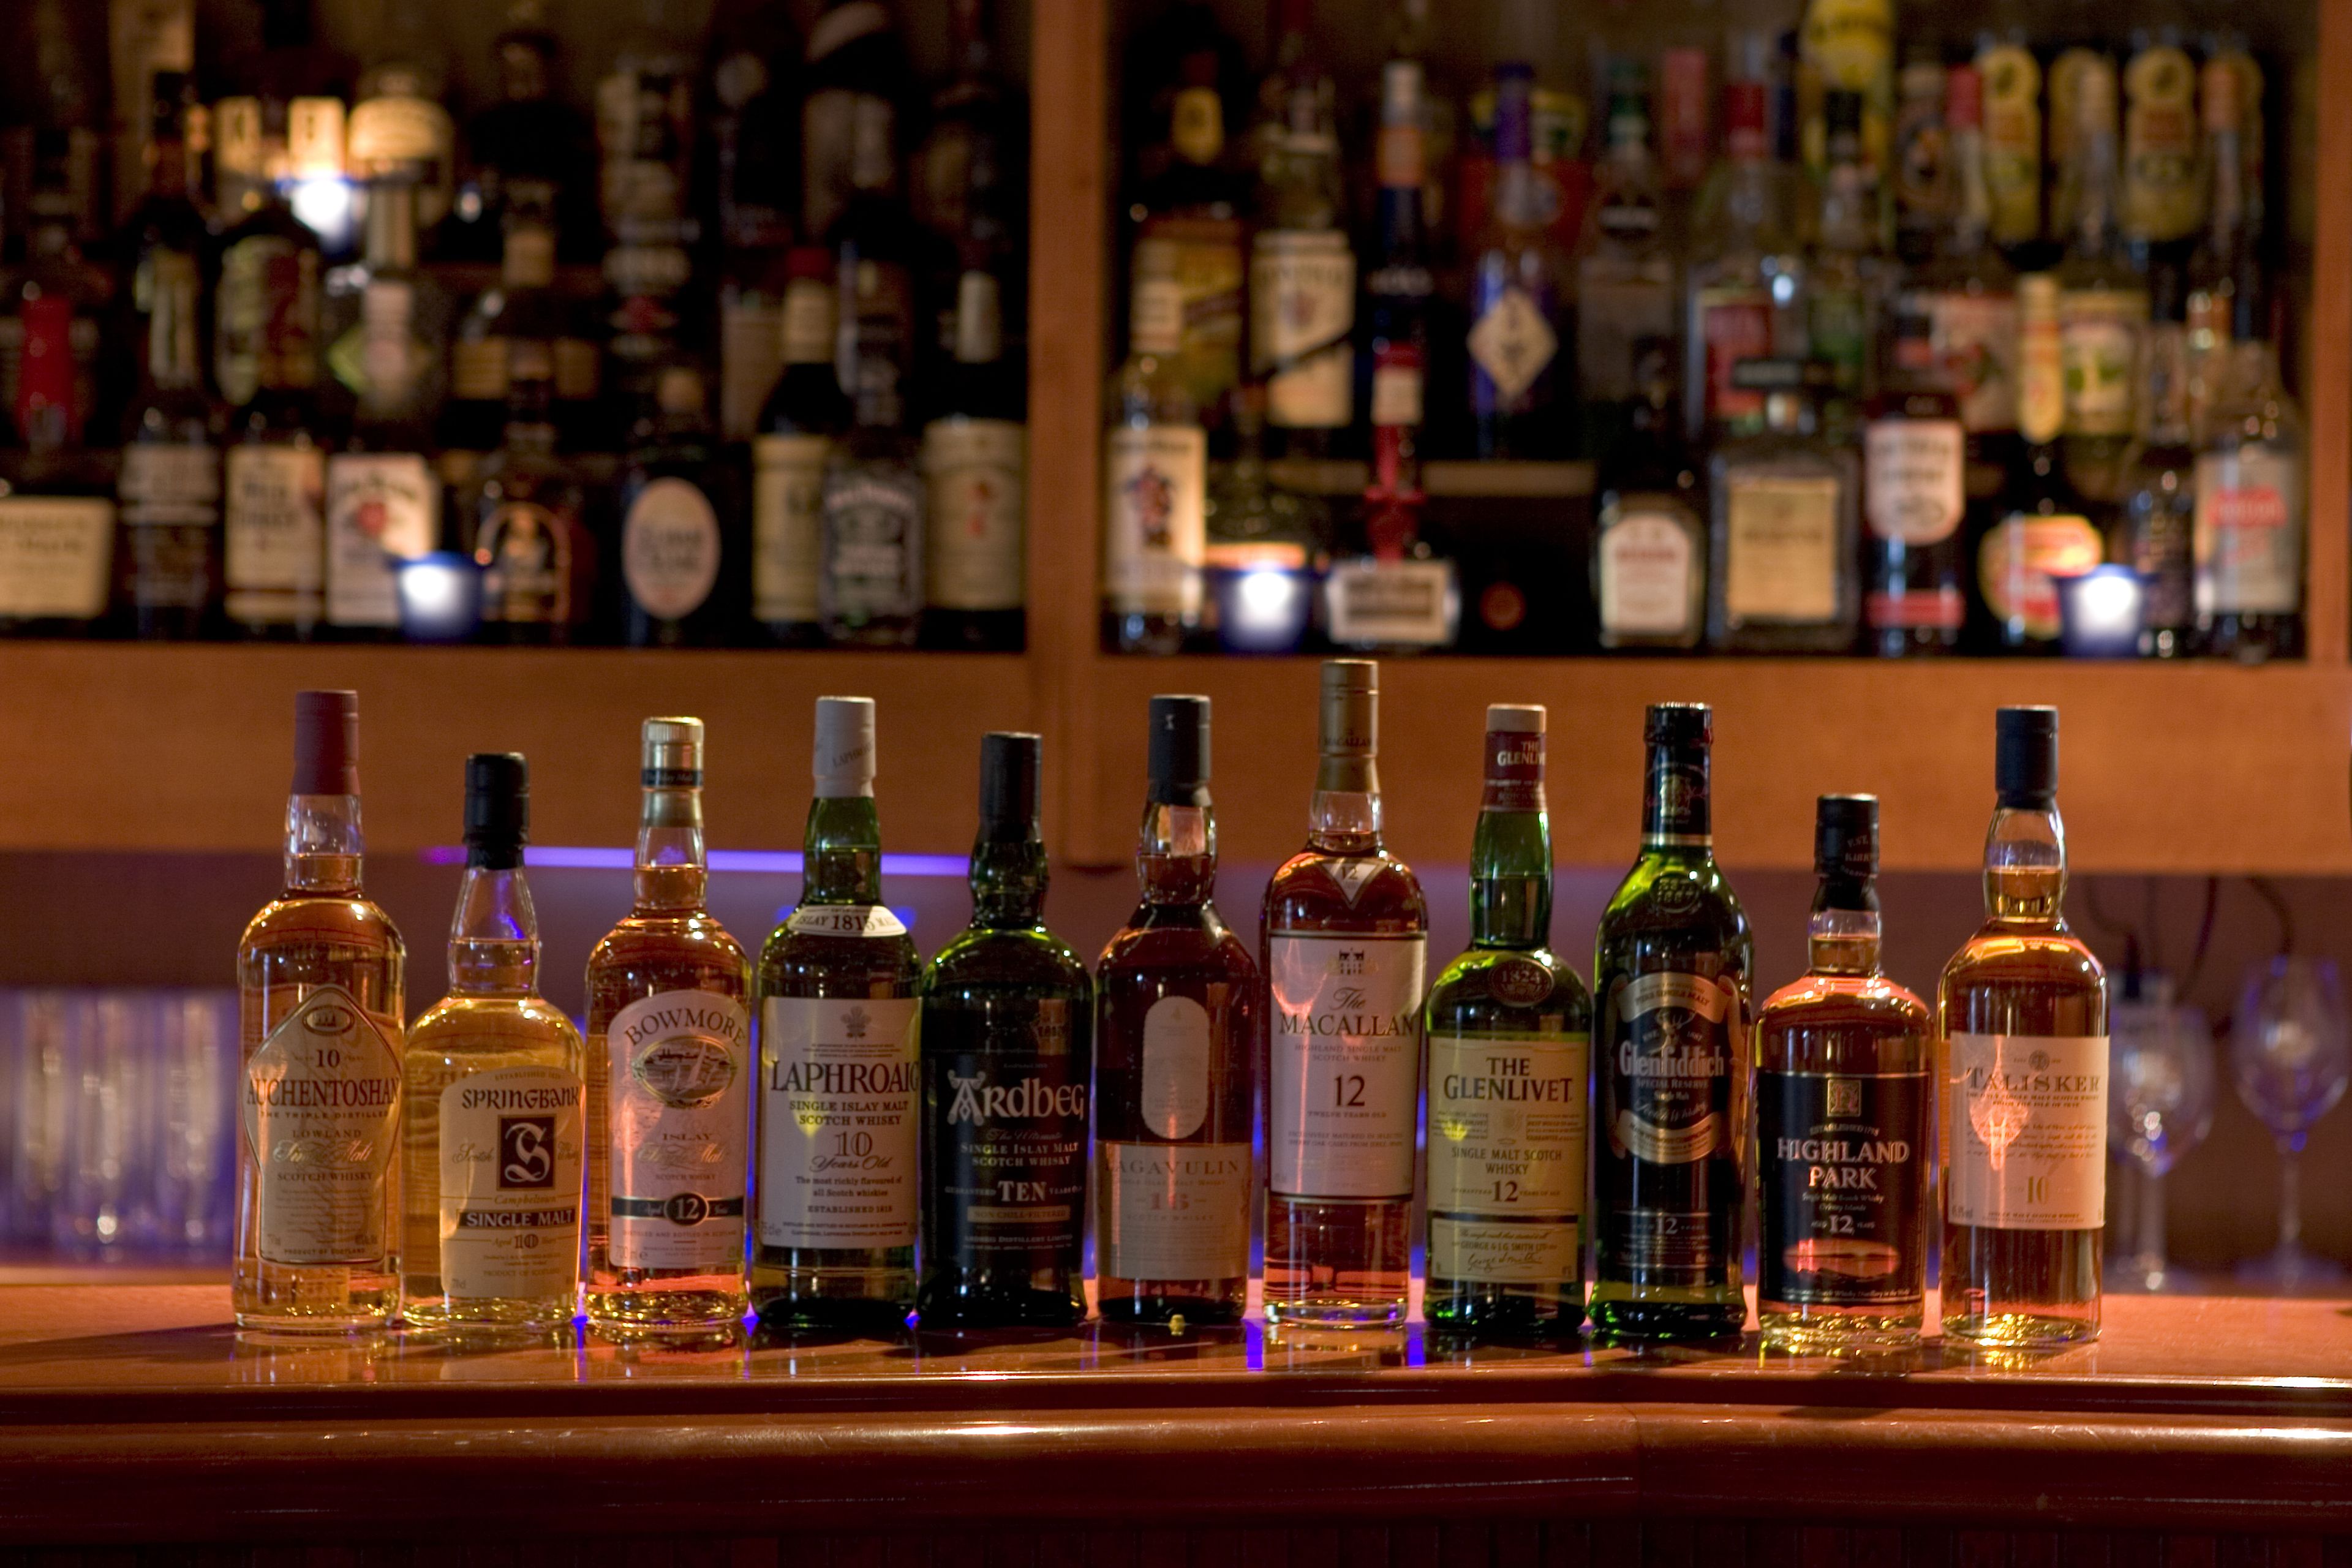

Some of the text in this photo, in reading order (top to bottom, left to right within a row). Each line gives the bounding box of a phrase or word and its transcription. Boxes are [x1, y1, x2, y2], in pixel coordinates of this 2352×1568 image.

[1328, 987, 1366, 1011] The
[624, 1008, 746, 1047] BOWMORE
[1278, 1011, 1414, 1037] MACALLAN
[315, 1049, 341, 1068] 10
[1294, 1045, 1343, 1054] HIGHLAND
[1619, 1040, 1724, 1078] Glenfiddich
[1485, 1057, 1531, 1077] THE
[1966, 1067, 2101, 1093] TALISKER
[461, 1085, 580, 1110] SPRINGBANK
[1333, 1074, 1366, 1107] 12
[789, 1100, 910, 1112] SINGLE ISLAY MALT
[799, 1115, 902, 1126] SCOTCH WHISKY
[293, 1129, 363, 1139] LOWLAND
[663, 1133, 714, 1142] ISLAY
[504, 1122, 551, 1183] S
[834, 1131, 873, 1157] 10
[960, 1142, 1079, 1155] SINGLE ISLAY MALT
[1776, 1137, 1911, 1164] HIGHLAND
[972, 1155, 1071, 1167] SCOTCH WHISKY
[1451, 1146, 1562, 1162] SINGLE MALT SCOTCH
[809, 1155, 894, 1173] Years Old
[1485, 1163, 1529, 1175] WHISKY
[277, 1171, 373, 1182] SCOTCH WHISKY
[796, 1176, 811, 1185] The
[834, 1176, 859, 1186] richly
[1808, 1166, 1877, 1190] PARK
[997, 1180, 1047, 1202] TEN
[1491, 1180, 1518, 1202] 12
[2027, 1175, 2049, 1205] 10
[466, 1209, 572, 1227] SINGLE MALT
[675, 1197, 700, 1221] 12
[1656, 1217, 1679, 1235] 12
[1828, 1214, 1855, 1235] 12
[514, 1234, 540, 1250] 10
[1511, 1242, 1534, 1251] SMITH
